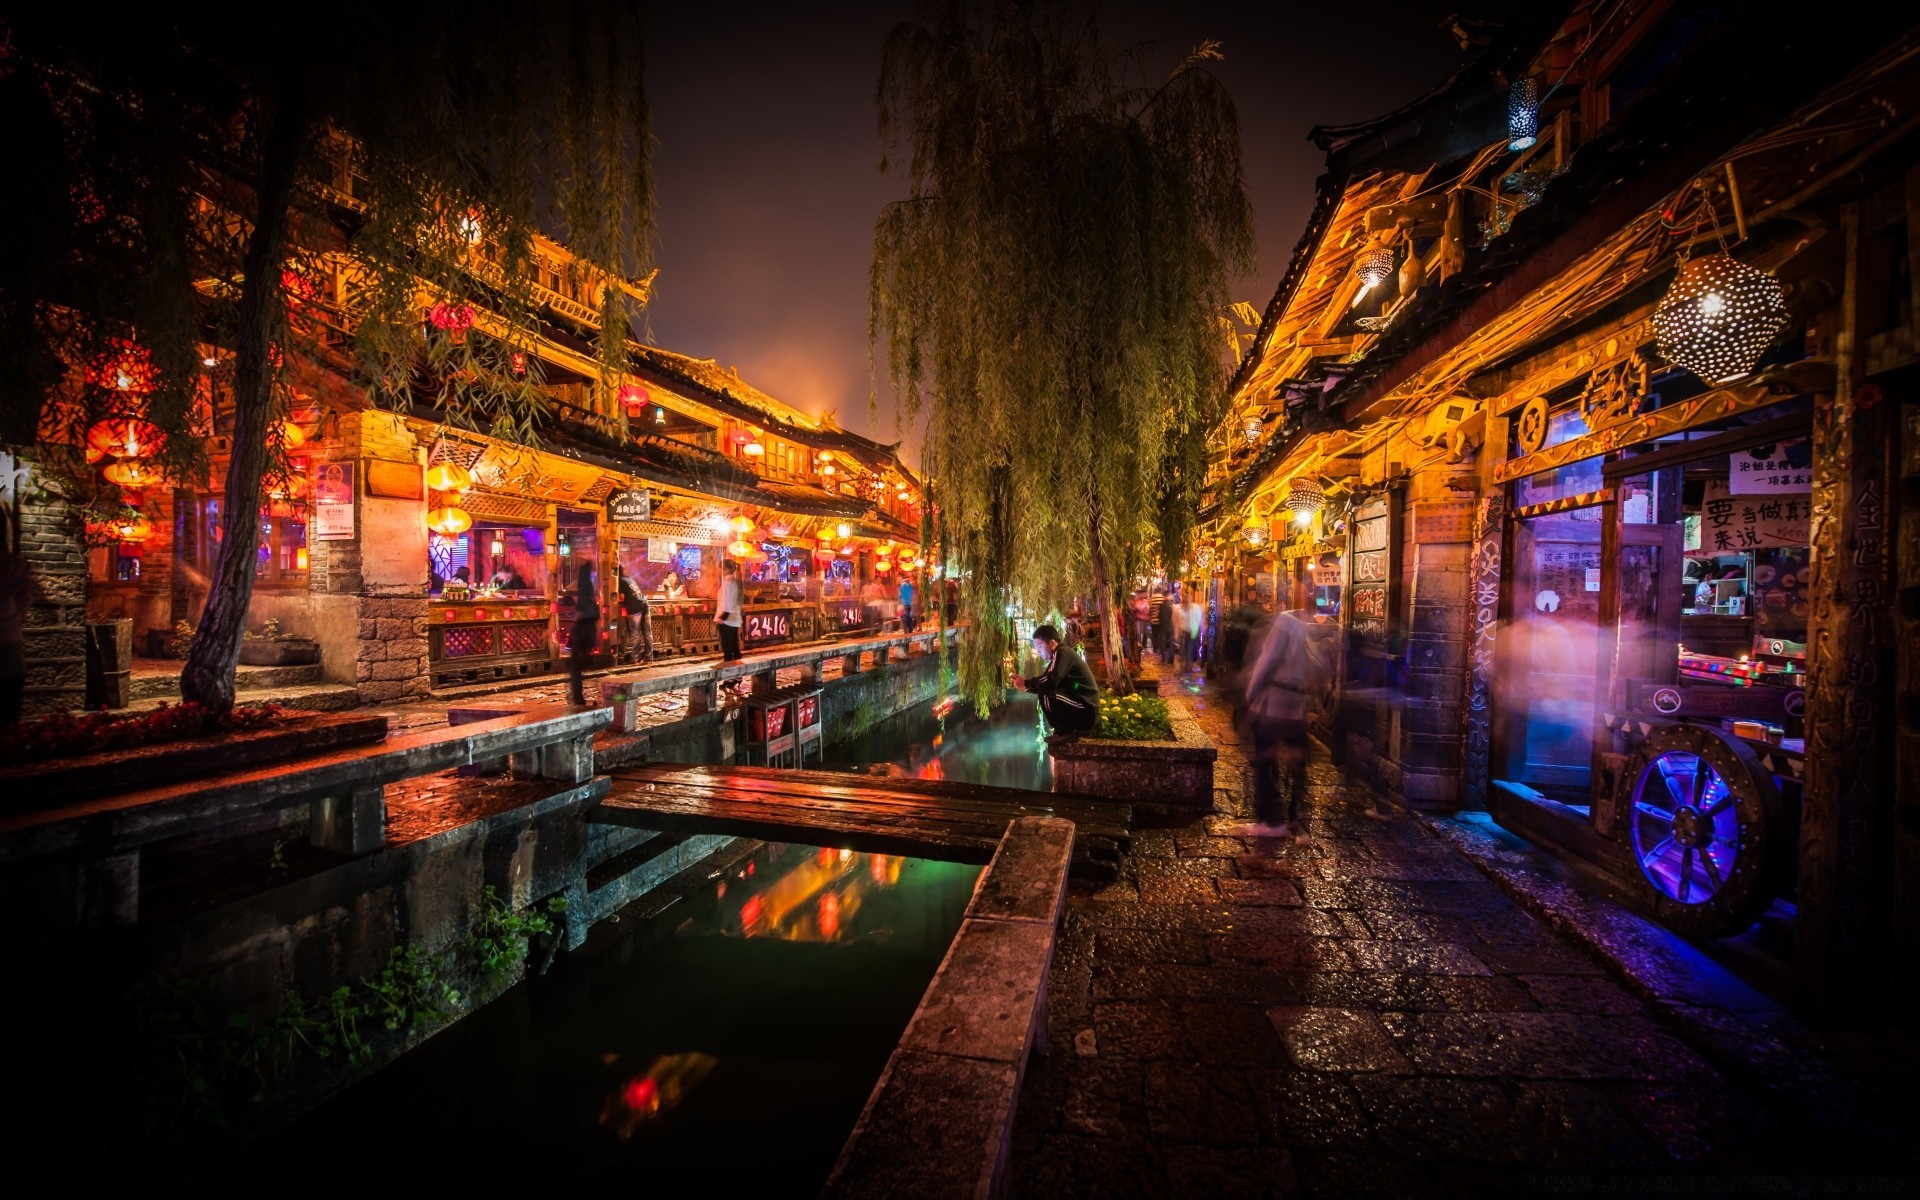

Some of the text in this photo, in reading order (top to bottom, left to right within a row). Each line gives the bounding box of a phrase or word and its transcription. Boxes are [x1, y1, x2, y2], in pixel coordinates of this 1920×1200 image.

[1740, 460, 1811, 472] 泡妞是櫻
[610, 493, 628, 506] Delta
[842, 608, 863, 625] 2416
[750, 616, 786, 638] 2416
